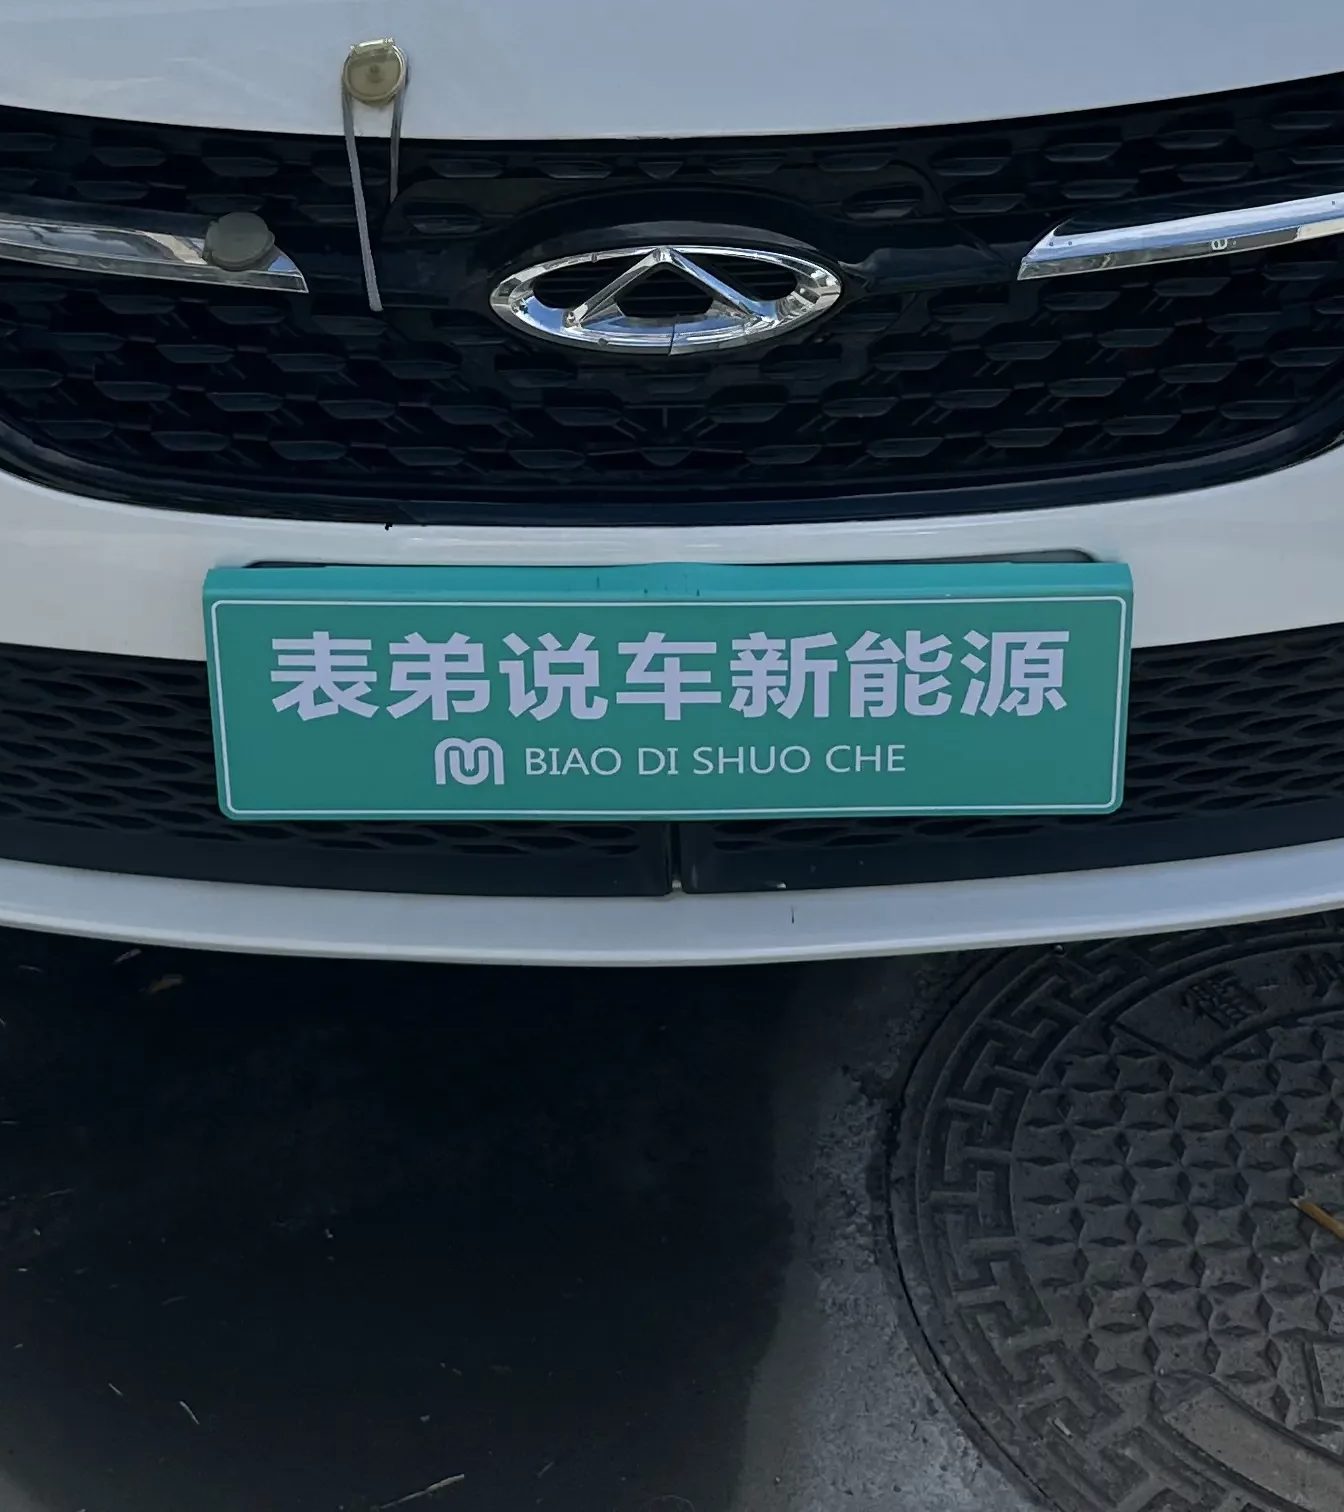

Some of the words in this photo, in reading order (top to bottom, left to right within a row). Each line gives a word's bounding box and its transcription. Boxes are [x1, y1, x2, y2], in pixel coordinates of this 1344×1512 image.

[269, 629, 1070, 721] 表弟说车新能源
[525, 746, 623, 776] BIAO
[638, 747, 678, 775] DI
[693, 745, 811, 775] SHUO
[825, 744, 907, 773] CHE
